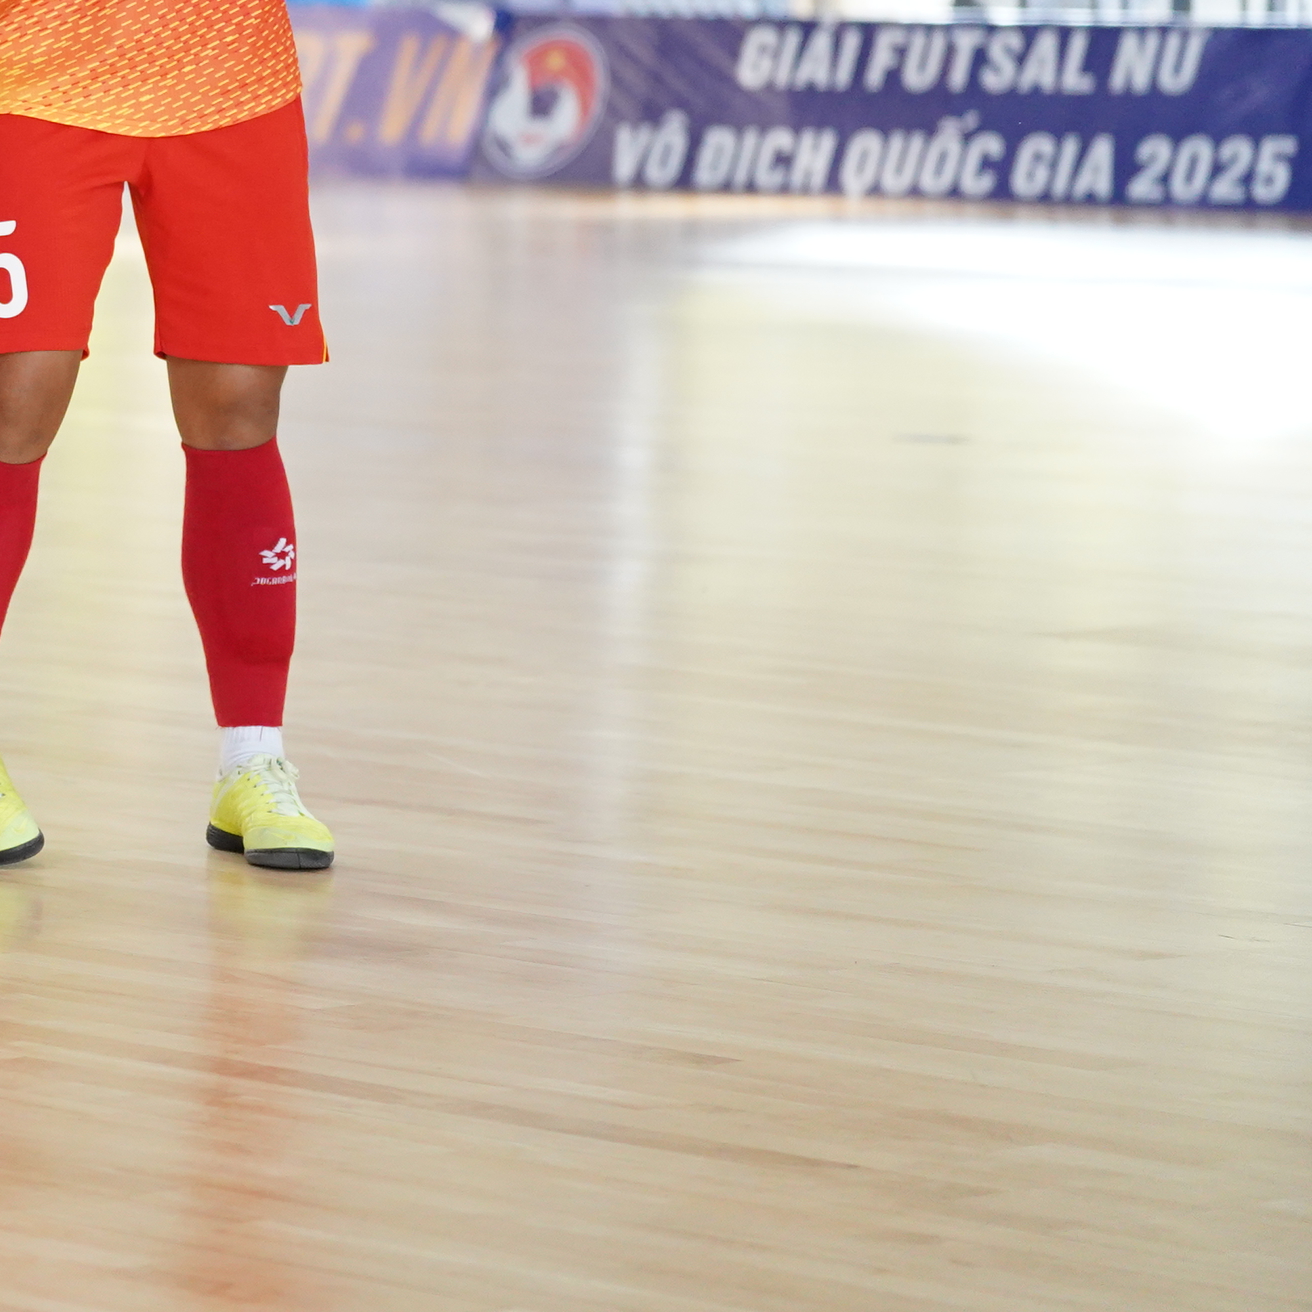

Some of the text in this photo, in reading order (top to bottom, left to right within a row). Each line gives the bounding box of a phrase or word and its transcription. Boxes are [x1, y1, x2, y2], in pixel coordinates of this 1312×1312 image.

[863, 24, 1096, 96] FUTSAL
[612, 107, 690, 190] VÔ
[838, 108, 1007, 202] QUỐC
[1008, 129, 1116, 201] GIA
[1126, 132, 1298, 207] 2025
